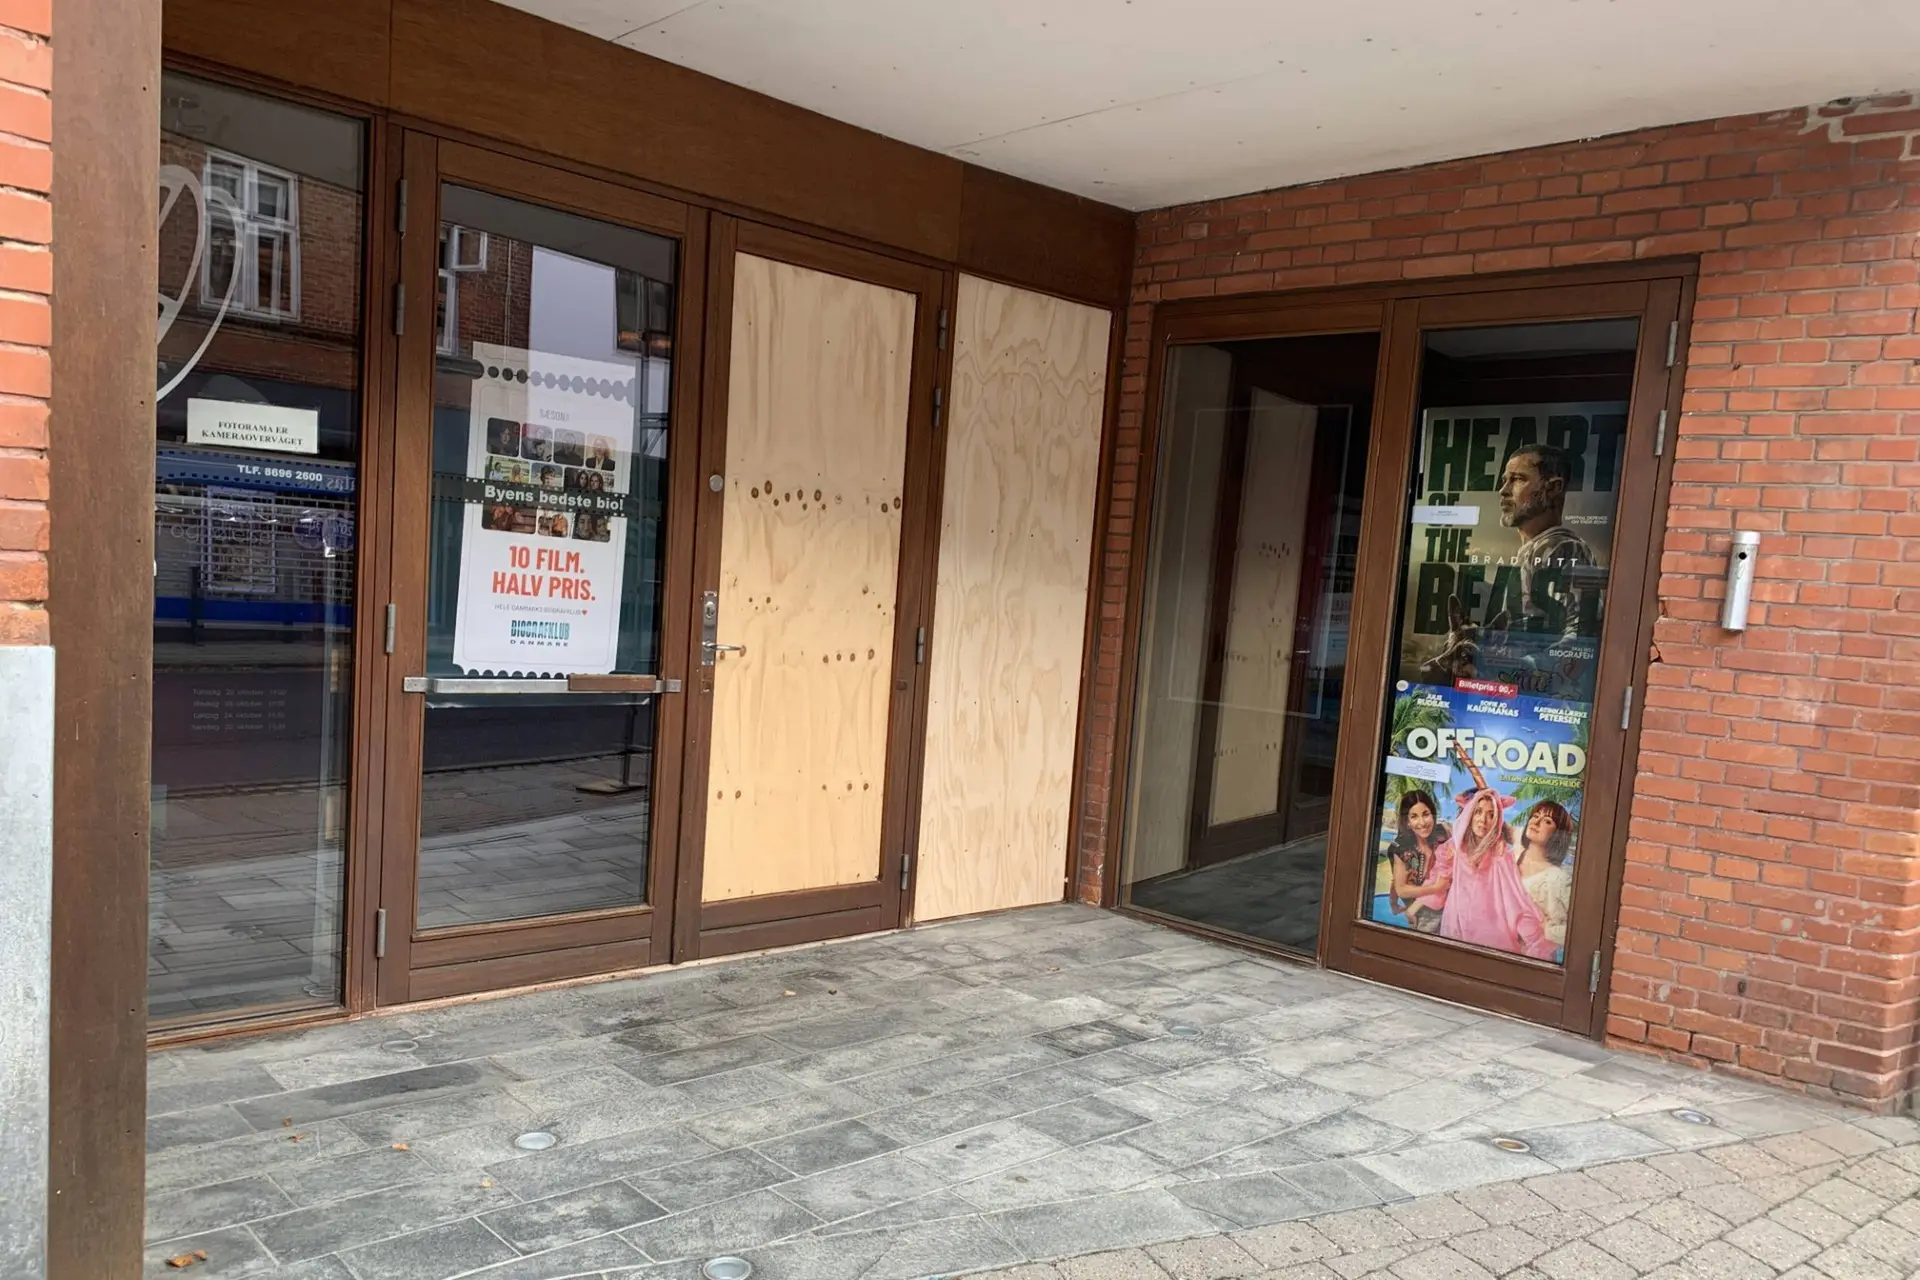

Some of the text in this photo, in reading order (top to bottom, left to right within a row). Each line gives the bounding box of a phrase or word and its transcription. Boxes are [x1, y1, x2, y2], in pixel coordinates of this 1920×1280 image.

[218, 421, 289, 434] FOTORAMA ER
[201, 429, 304, 446] KAMERAOVERVÅGET
[237, 464, 323, 482] TLF. 8696 2600
[484, 484, 624, 511] Byens bedste bio!
[1425, 528, 1473, 563] THE
[509, 545, 585, 574] 10 FILM.
[1471, 553, 1579, 568] BRAD PITT
[492, 571, 596, 602] HALV PRIS.
[510, 639, 569, 648] DANMARK
[1549, 649, 1594, 660] BIOGRAFEN
[1458, 680, 1497, 692] Billetpris:
[1539, 712, 1581, 725] PETERSEN
